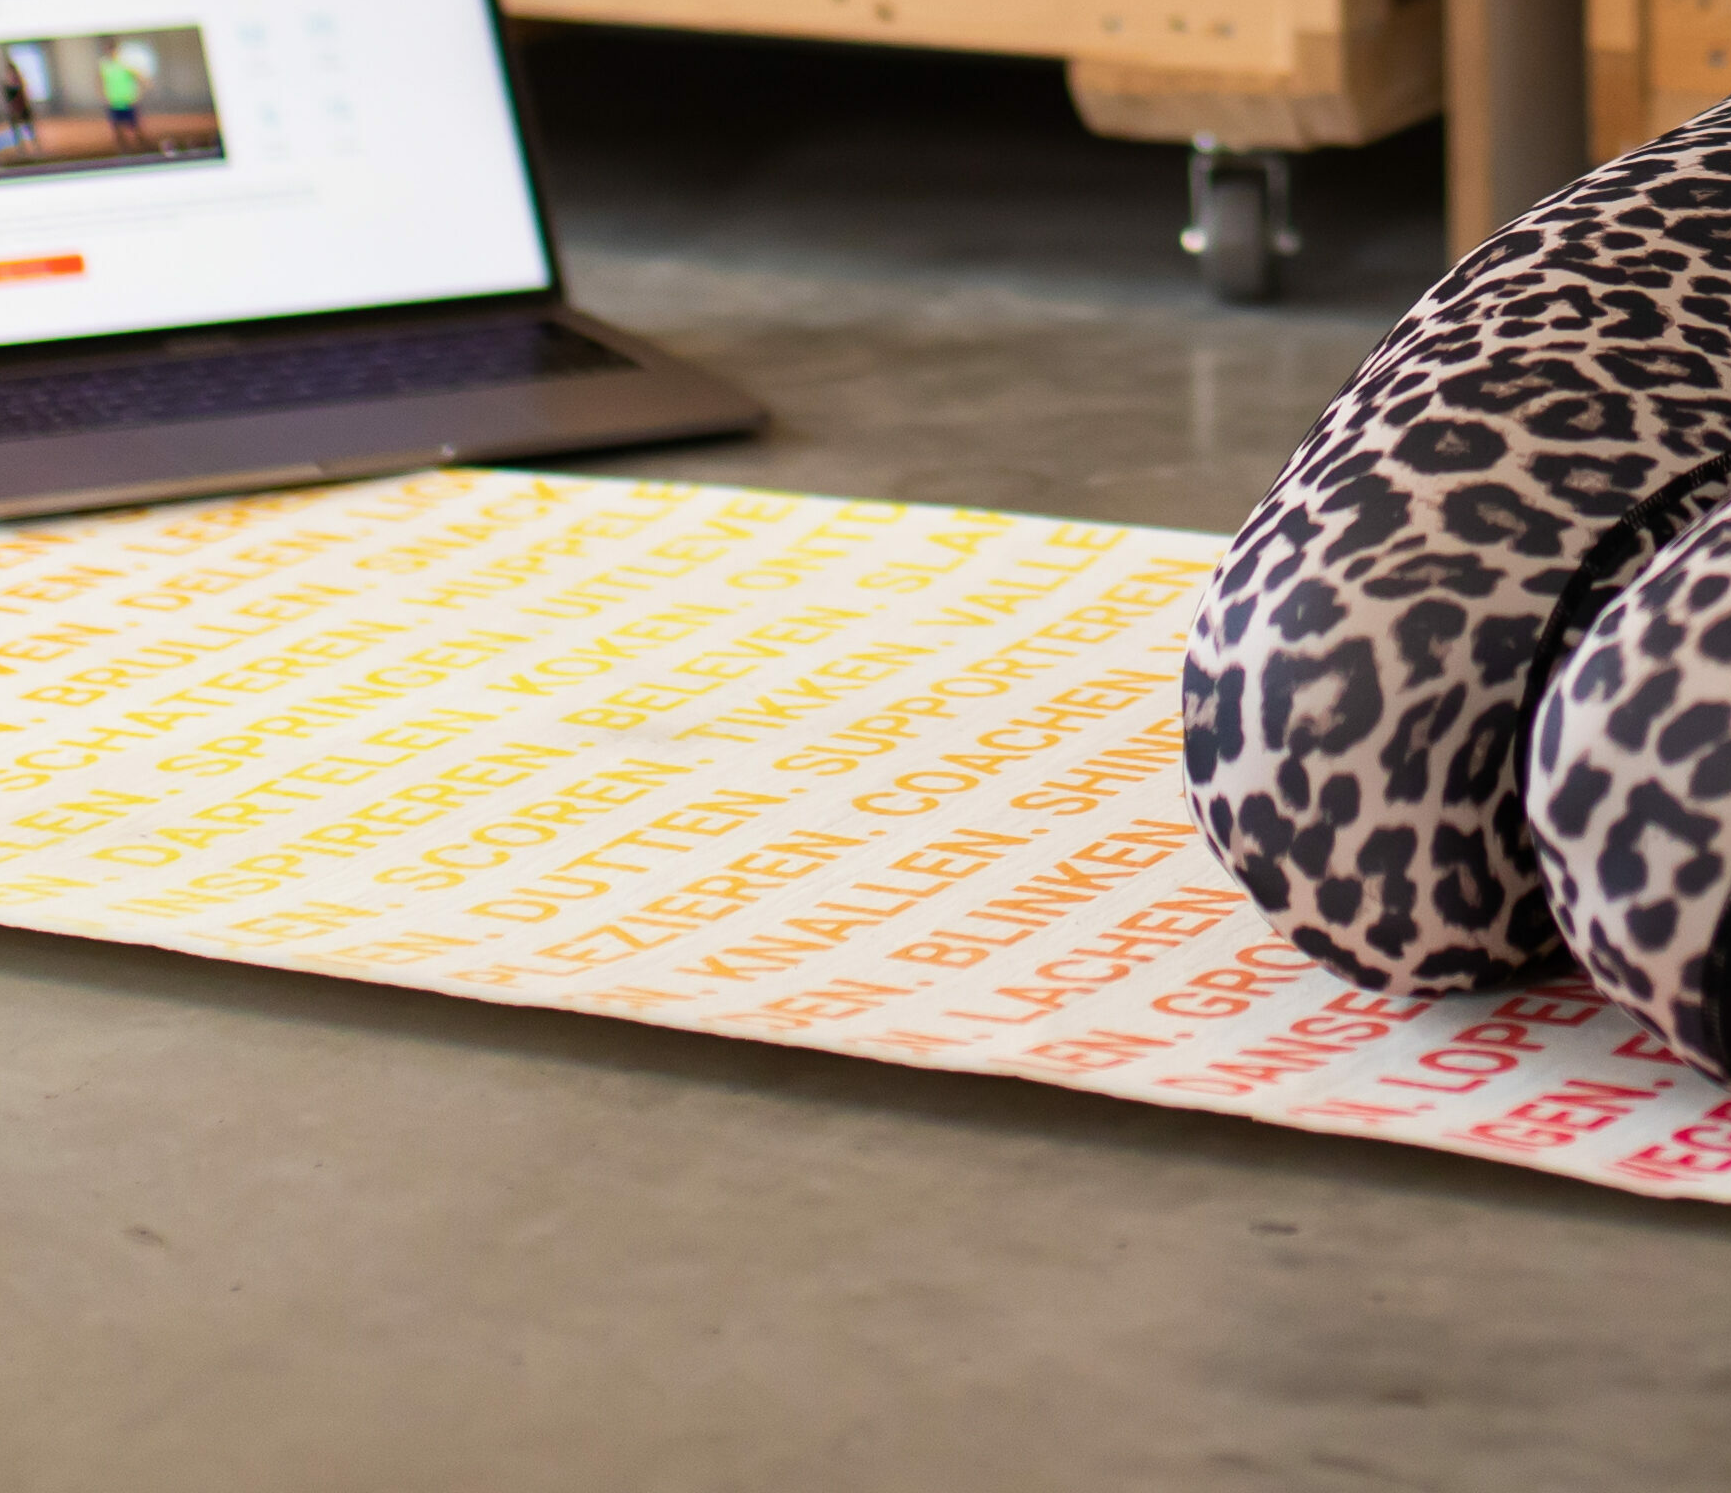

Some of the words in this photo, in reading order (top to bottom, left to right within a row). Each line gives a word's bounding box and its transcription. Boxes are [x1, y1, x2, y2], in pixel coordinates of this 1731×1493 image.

[18, 582, 378, 707] BRULLEN.
[113, 529, 374, 611] DELEN.
[157, 629, 552, 776] SPRINGEN.
[518, 493, 804, 619] UITLEVE
[88, 705, 521, 866] DARTELEN.
[486, 599, 754, 695] KOKEN.
[107, 741, 596, 918] INSPIREREN.
[559, 604, 888, 729] BELEVEN.
[374, 758, 715, 890] SCOREN.
[670, 639, 957, 743] TIKKEN.
[447, 829, 888, 987] PLEZIEREN.
[464, 787, 808, 922] DUTTEN.
[674, 828, 1049, 980] KNALLEN.
